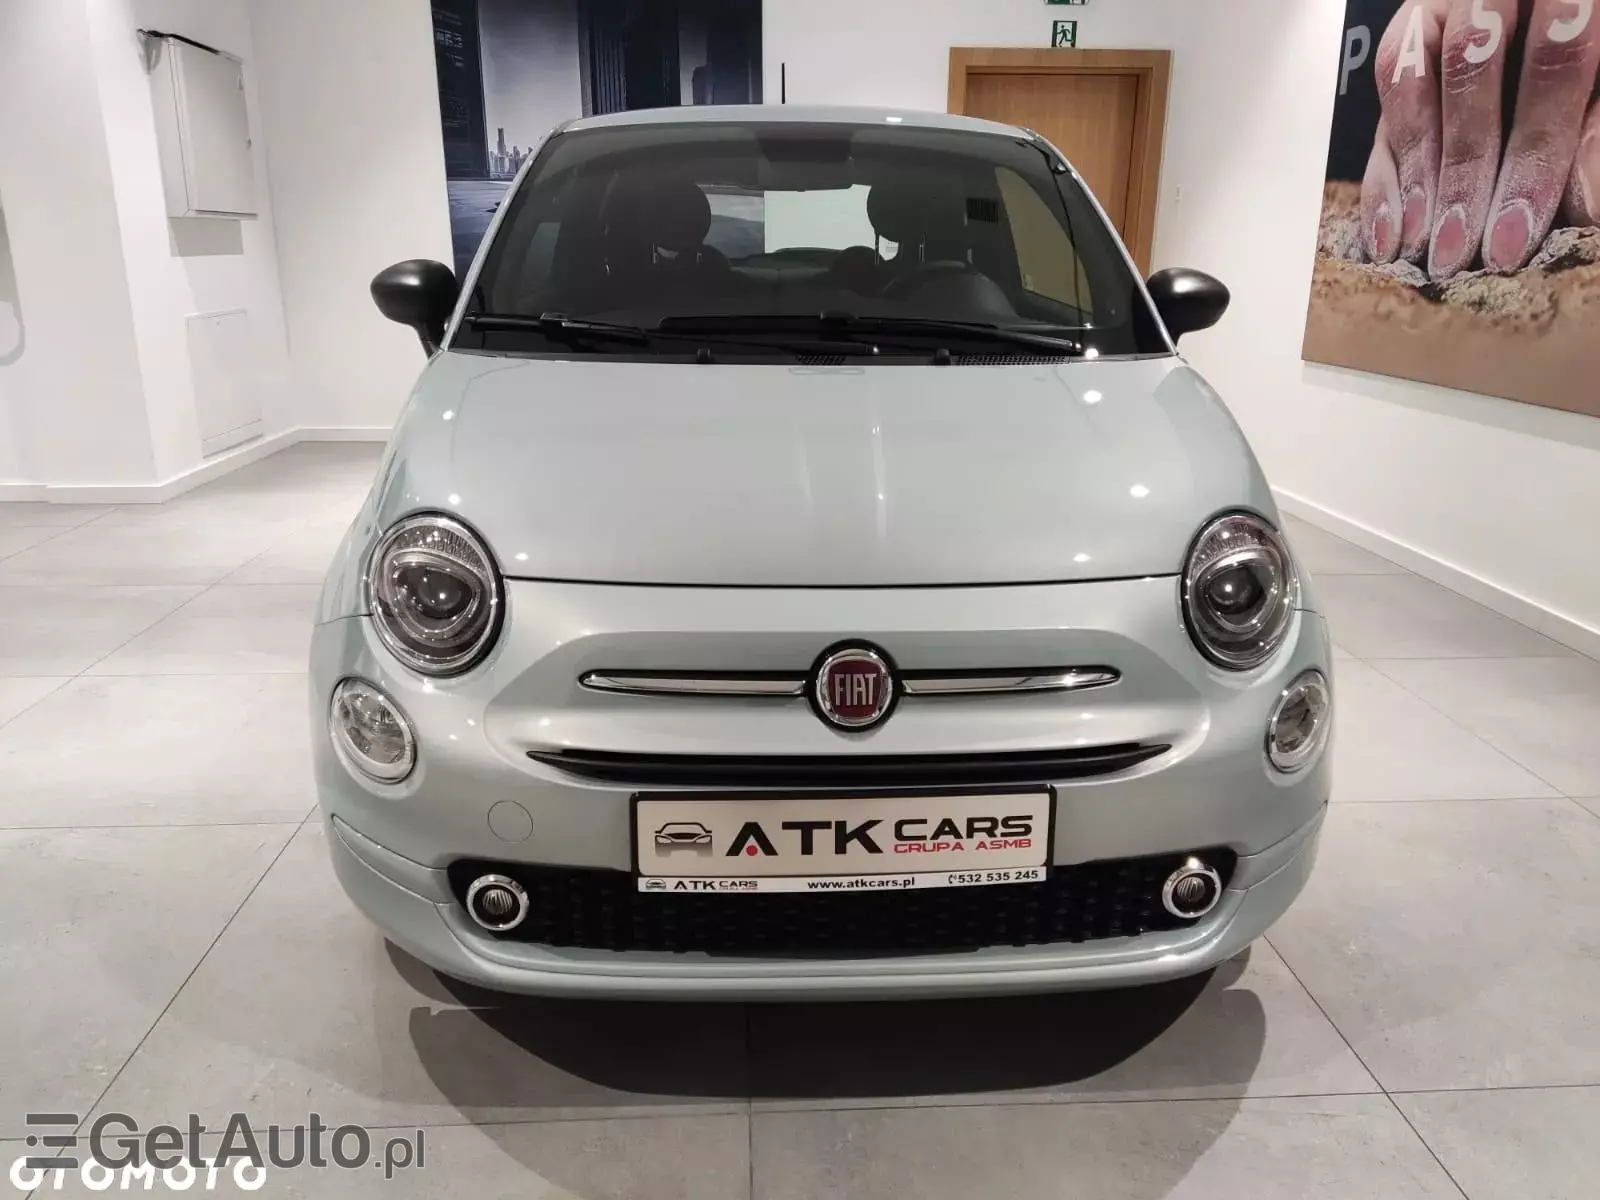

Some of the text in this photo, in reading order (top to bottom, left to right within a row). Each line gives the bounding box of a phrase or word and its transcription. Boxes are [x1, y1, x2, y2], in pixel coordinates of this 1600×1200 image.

[834, 673, 877, 706] FIAT
[725, 815, 1033, 857] ATK CARS
[894, 838, 1032, 854] GRUPA ASMB
[807, 877, 916, 889] www.atkcars.pl
[957, 870, 1039, 884] 532 535 245
[674, 880, 716, 890] ATK
[719, 880, 759, 888] CARS
